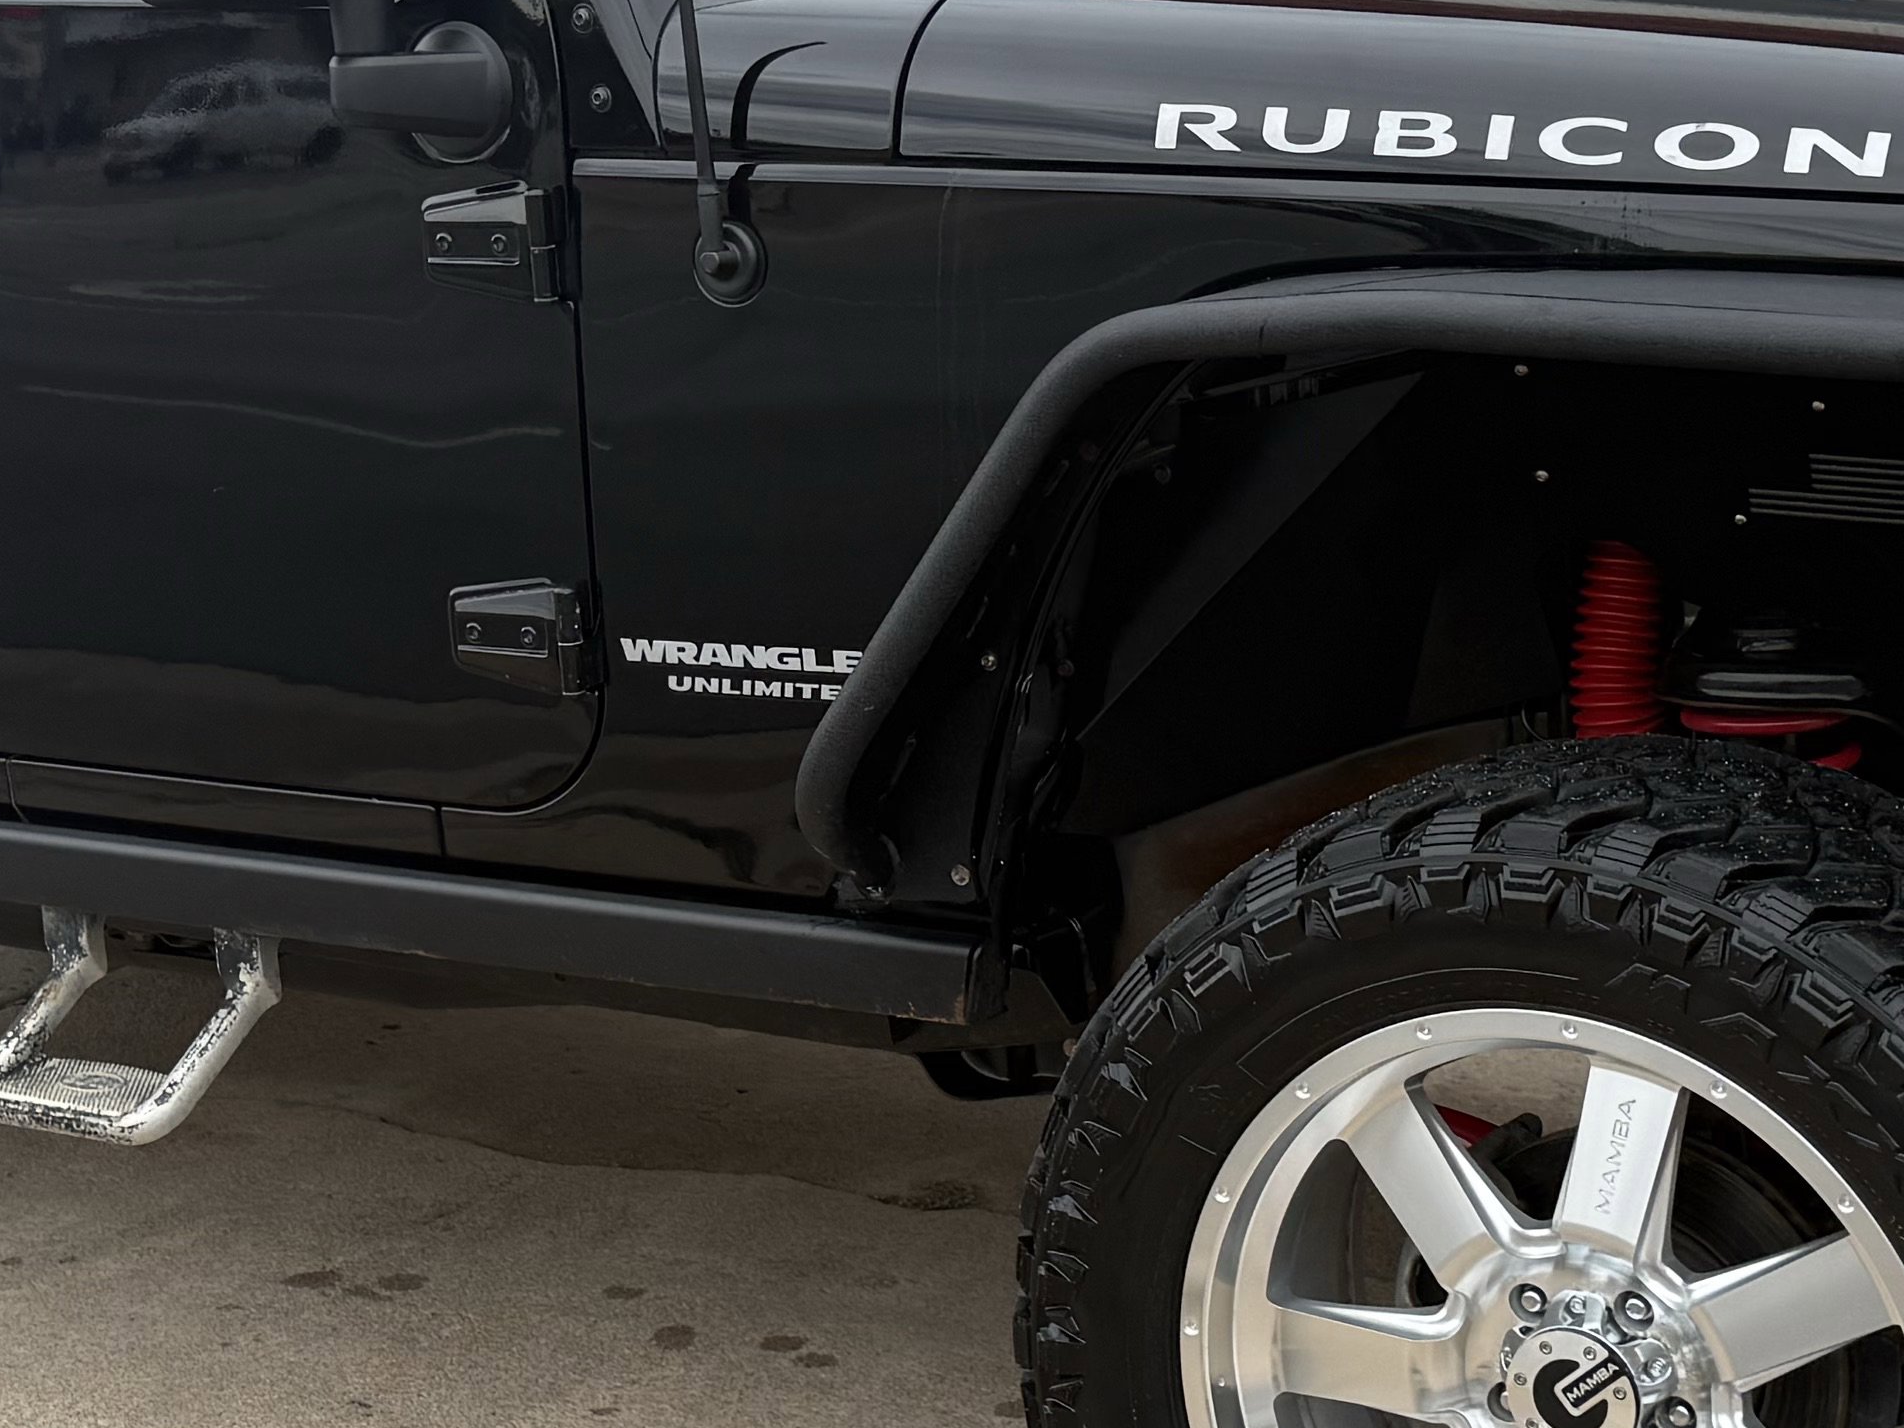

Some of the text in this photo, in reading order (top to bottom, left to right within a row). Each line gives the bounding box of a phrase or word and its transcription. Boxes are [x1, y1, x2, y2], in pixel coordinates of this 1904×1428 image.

[1153, 102, 1893, 178] RUBICON
[619, 637, 864, 674] WRANGLE
[667, 674, 844, 701] UNLIMITE
[1593, 1098, 1637, 1215] MAMBA
[1565, 1362, 1621, 1403] MAMBA
